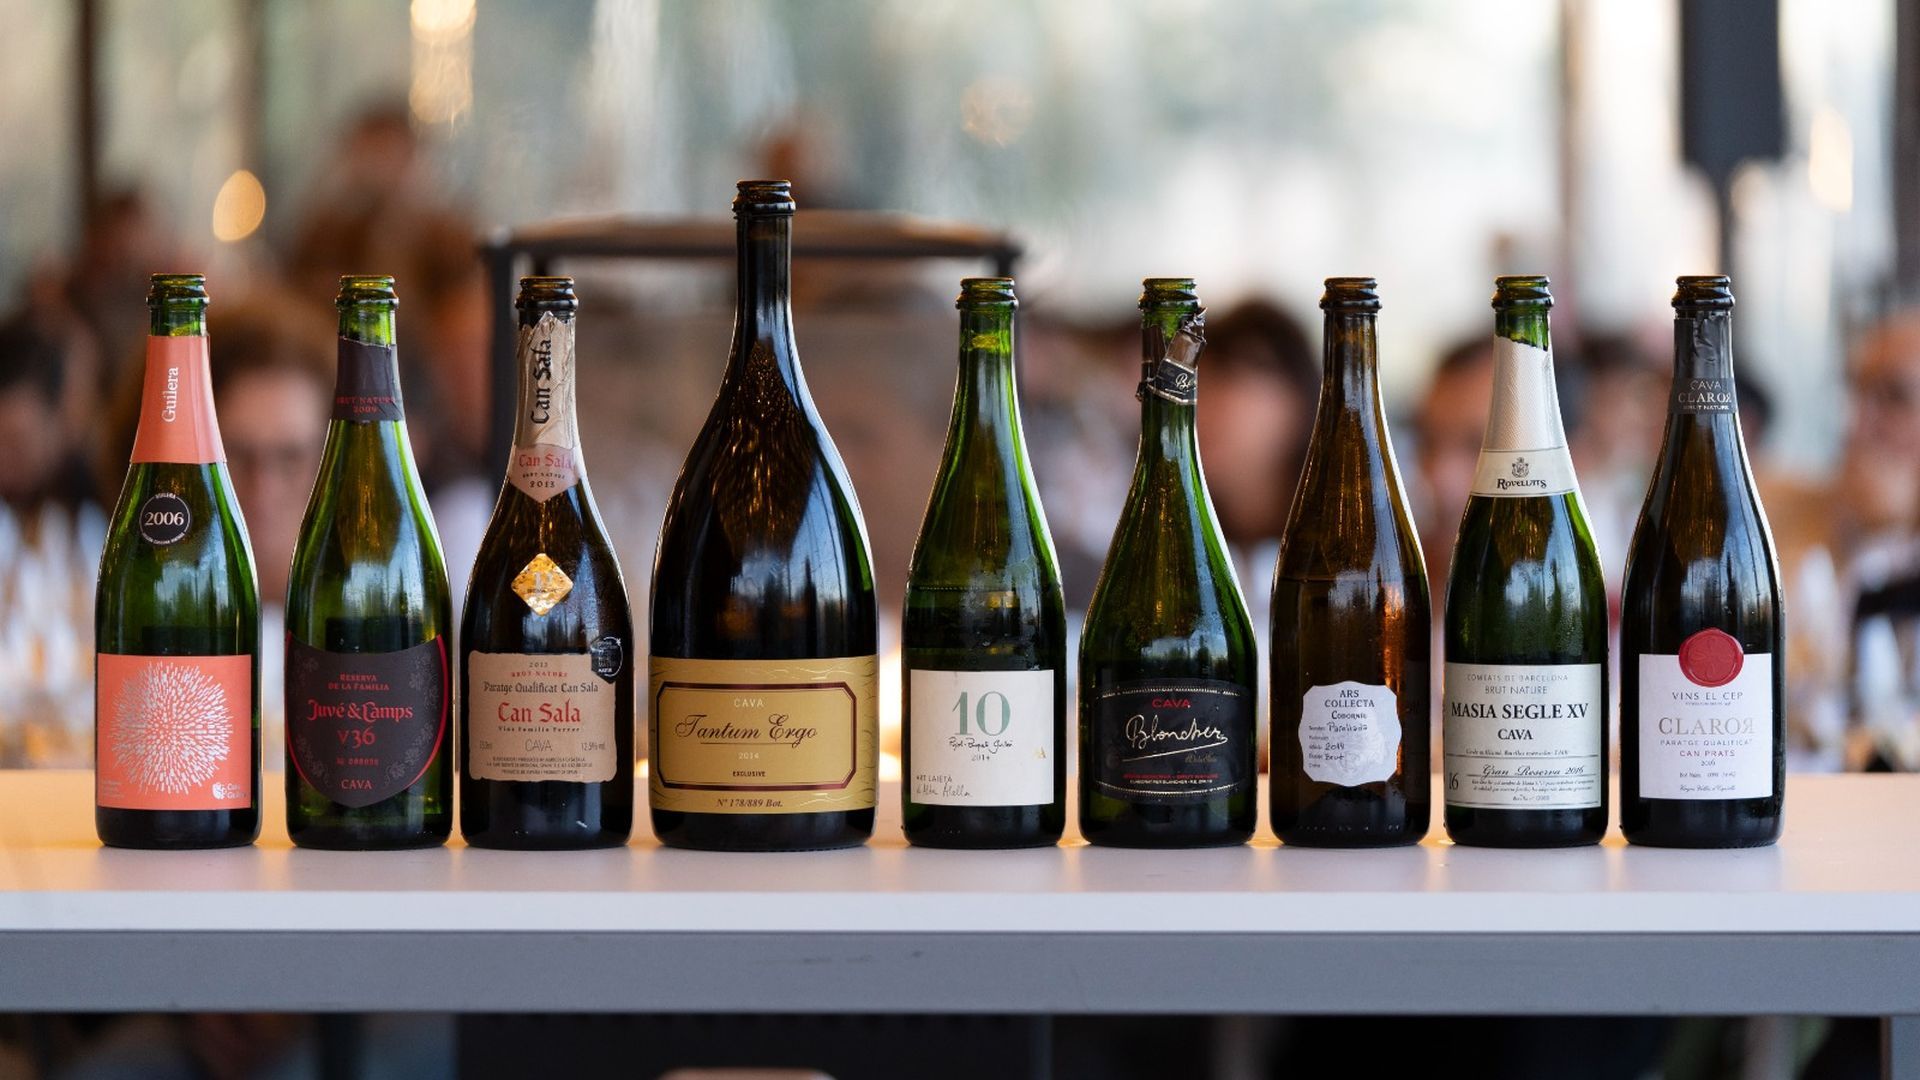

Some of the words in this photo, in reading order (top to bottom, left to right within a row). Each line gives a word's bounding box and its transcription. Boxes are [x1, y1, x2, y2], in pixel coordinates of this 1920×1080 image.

[531, 338, 552, 380] Sala
[1690, 380, 1721, 390] CAVA
[161, 366, 179, 423] Guilera
[531, 387, 550, 424] Can
[518, 454, 540, 468] Can
[544, 452, 573, 470] Sala
[529, 480, 557, 489] 2013
[143, 511, 185, 526] 2006
[340, 674, 378, 682] RESERVA
[1518, 674, 1568, 682] BARCELONA
[354, 683, 391, 691] FAMILIA
[483, 681, 513, 696] Paratge
[514, 681, 558, 693] Qualificat
[560, 682, 579, 693] Can
[580, 681, 598, 693] Sala
[1485, 686, 1507, 695] BRUT
[1510, 686, 1548, 695] NATURE
[1339, 690, 1359, 698] ARS
[1671, 692, 1700, 701] VINS
[1705, 692, 1717, 701] EL
[1722, 692, 1744, 701] CEP
[733, 698, 765, 708] CAVA
[1151, 698, 1191, 709] CAVA
[1324, 699, 1375, 708] COLLECTA
[307, 699, 346, 721] Juvé
[348, 702, 363, 720] &
[362, 701, 414, 724] Camps
[498, 700, 532, 723] Can
[539, 697, 582, 723] Sala
[951, 691, 1011, 736] 10
[1451, 702, 1498, 719] MASIA
[1502, 703, 1563, 720] SEGLE
[1567, 702, 1589, 719] XV
[675, 714, 761, 739] Tantum
[768, 713, 818, 749] Ergo
[1498, 728, 1534, 740] CAVA
[525, 738, 553, 752] CAVA
[738, 752, 760, 760] 2014
[1482, 763, 1509, 780] Gran
[1514, 764, 1561, 777] Reserva
[1564, 765, 1585, 776] 2016
[341, 779, 374, 790] CAVA
[730, 799, 764, 808] 178/889
[765, 799, 784, 807] Bot.
